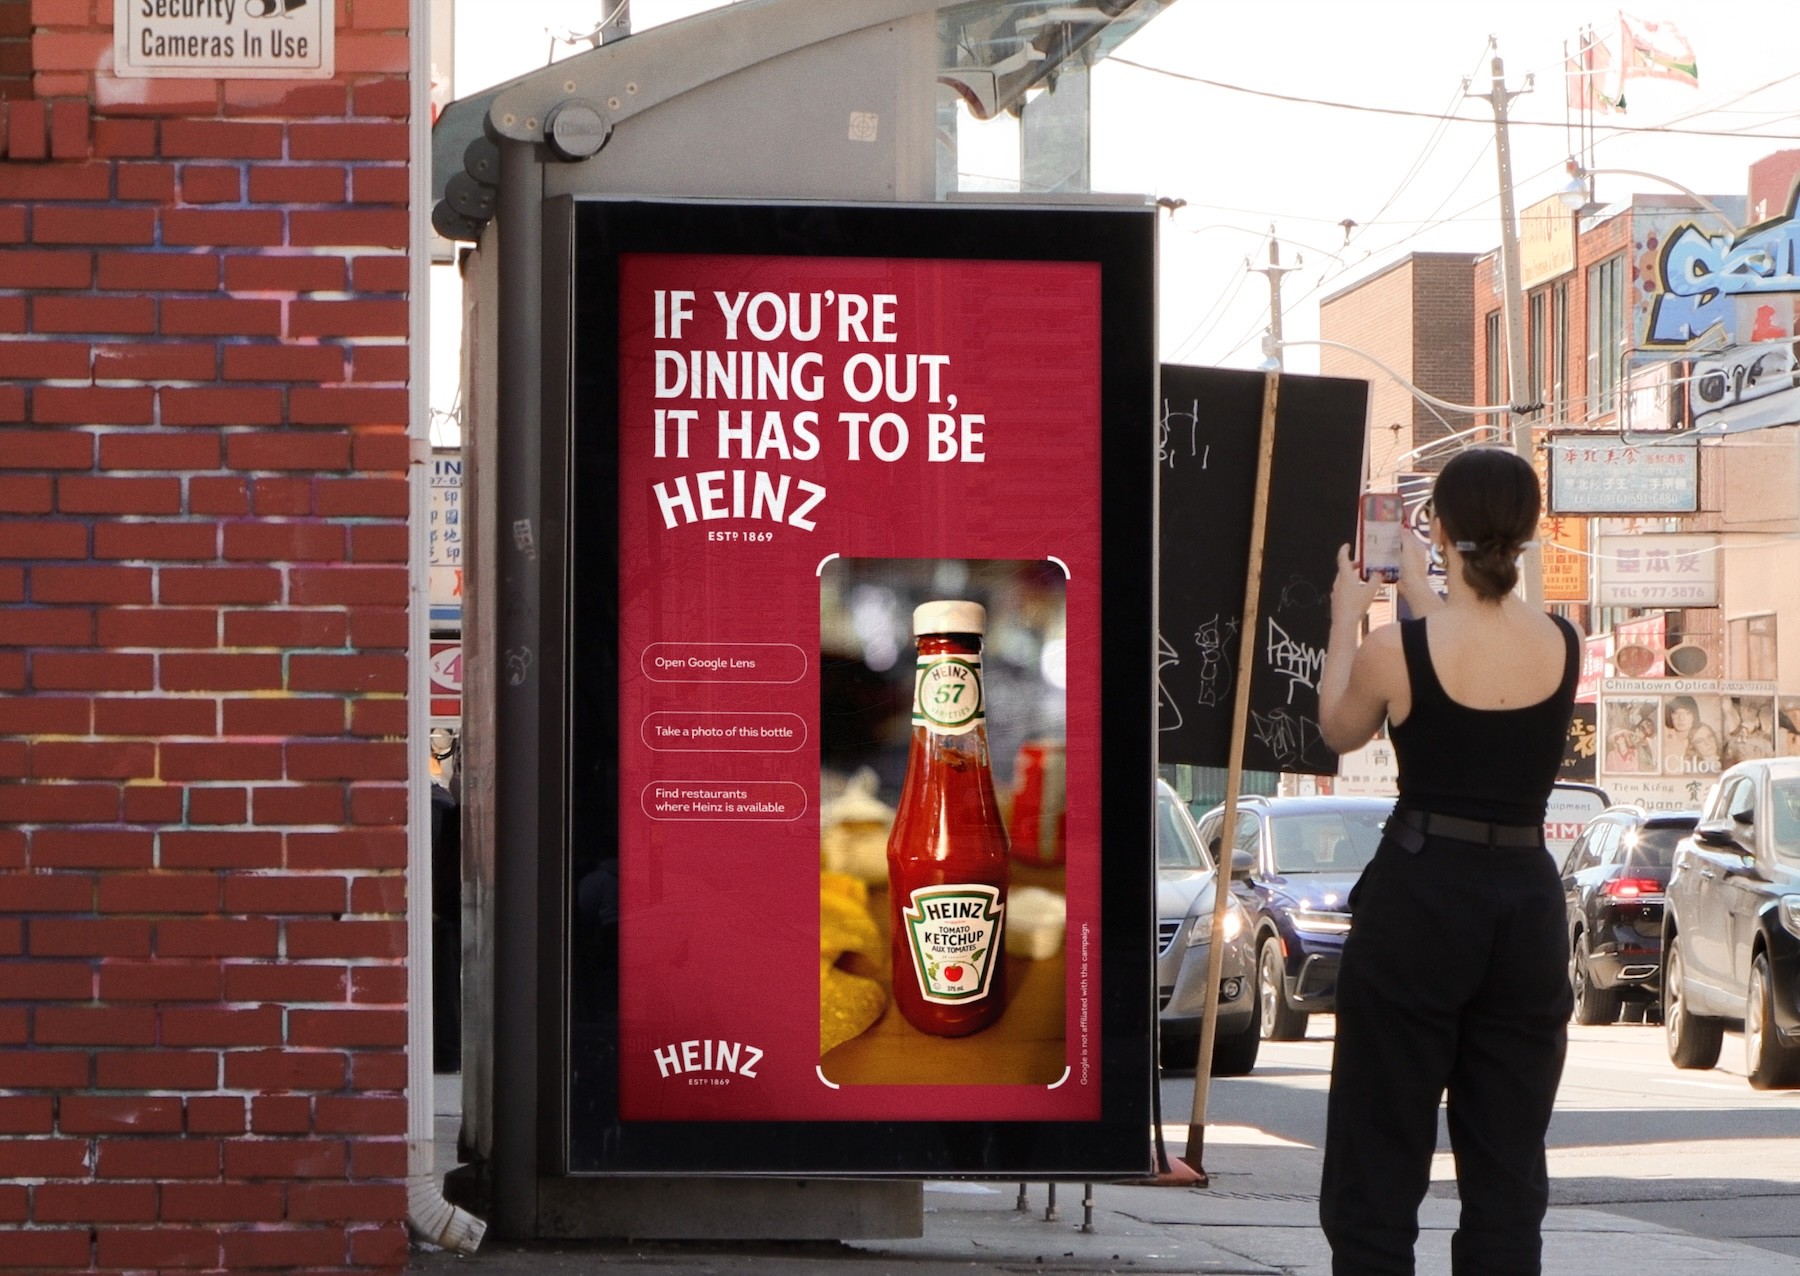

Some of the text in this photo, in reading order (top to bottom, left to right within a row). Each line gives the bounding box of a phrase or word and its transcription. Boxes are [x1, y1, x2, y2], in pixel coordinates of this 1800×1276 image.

[142, 0, 235, 25] Security
[142, 28, 308, 58] Cameras In Use
[655, 290, 897, 342] IF YOU'RE
[655, 350, 957, 410] DINING OUT,
[654, 410, 985, 462] IT HAS TO BE
[431, 461, 462, 475] IN
[653, 470, 826, 531] HEINZ
[743, 532, 773, 541] 1869
[1611, 586, 1705, 598] TEL: 977-5876
[655, 657, 755, 670] Open Google Lens
[932, 666, 968, 680] HEINZ
[1606, 680, 1671, 690] Chinatown
[1675, 680, 1721, 692] Optical
[935, 684, 966, 704] 57
[656, 726, 680, 736] Take
[692, 726, 723, 738] photo
[725, 727, 737, 736] of
[739, 727, 758, 736] this
[761, 727, 793, 737] bottle
[656, 788, 747, 799] Find restaurants
[656, 802, 784, 812] where Heinz is available
[1547, 803, 1591, 811] uipment
[927, 902, 983, 920] HEINZ
[925, 930, 984, 946] KETCHUP
[932, 944, 976, 954] AUX TOMATES
[1080, 922, 1090, 1085] Google is not affiliated with this campaign.
[653, 1040, 764, 1079] HEINZ
